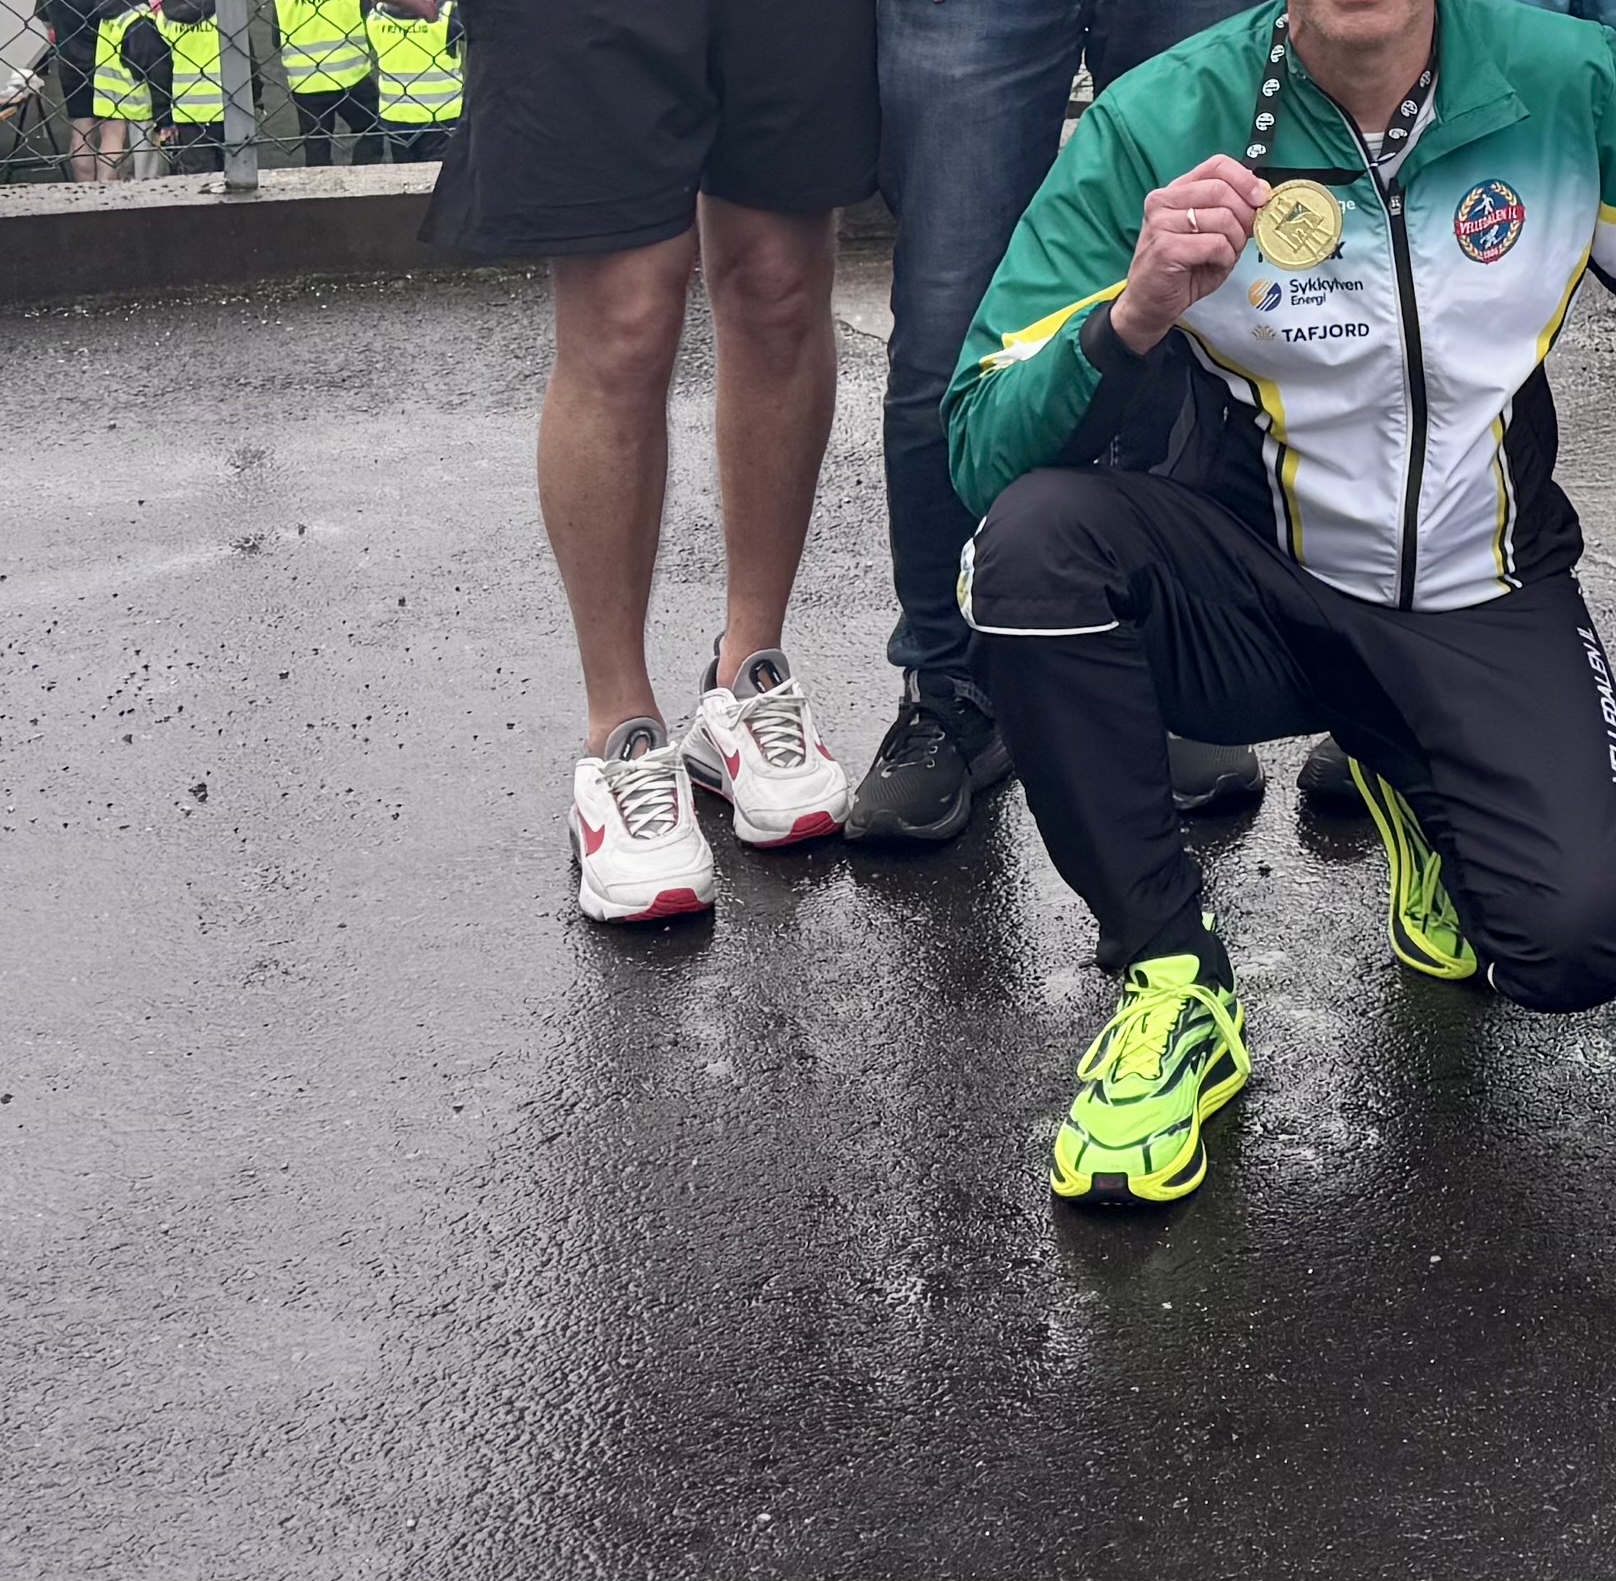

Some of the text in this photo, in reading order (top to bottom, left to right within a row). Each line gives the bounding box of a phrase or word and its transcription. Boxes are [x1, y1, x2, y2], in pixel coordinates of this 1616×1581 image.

[1289, 277, 1364, 295] Sykkylven
[1291, 292, 1327, 306] Energi
[1281, 323, 1370, 343] TAFJORD
